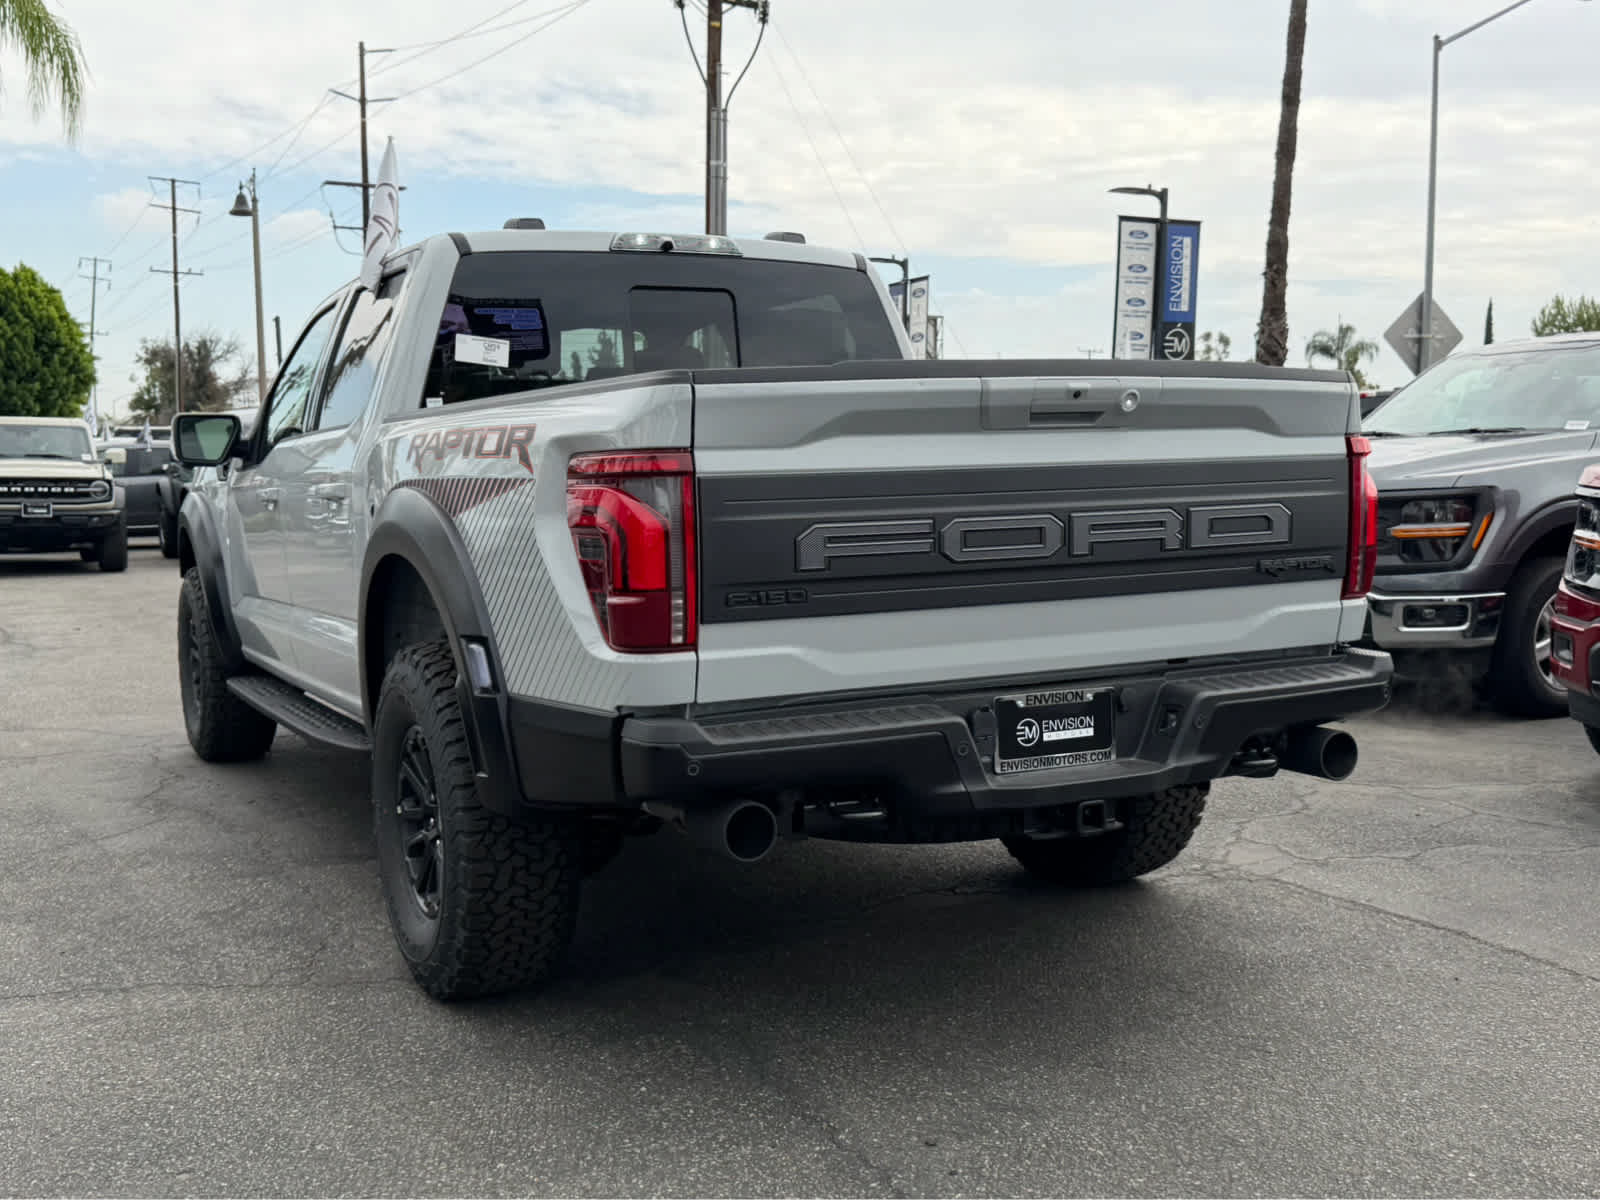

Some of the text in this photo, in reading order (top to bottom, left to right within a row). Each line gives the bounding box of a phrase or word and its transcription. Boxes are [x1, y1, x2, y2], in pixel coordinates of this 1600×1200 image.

[1169, 235, 1184, 312] ENVISION
[406, 423, 537, 475] RAPTOR
[795, 502, 1293, 573] FORD
[1256, 554, 1336, 577] RAPTOR
[1025, 691, 1084, 706] ENVISION
[1042, 715, 1095, 732] ENVISION
[1000, 751, 1112, 772] ENVISIONMOTORS.COM
